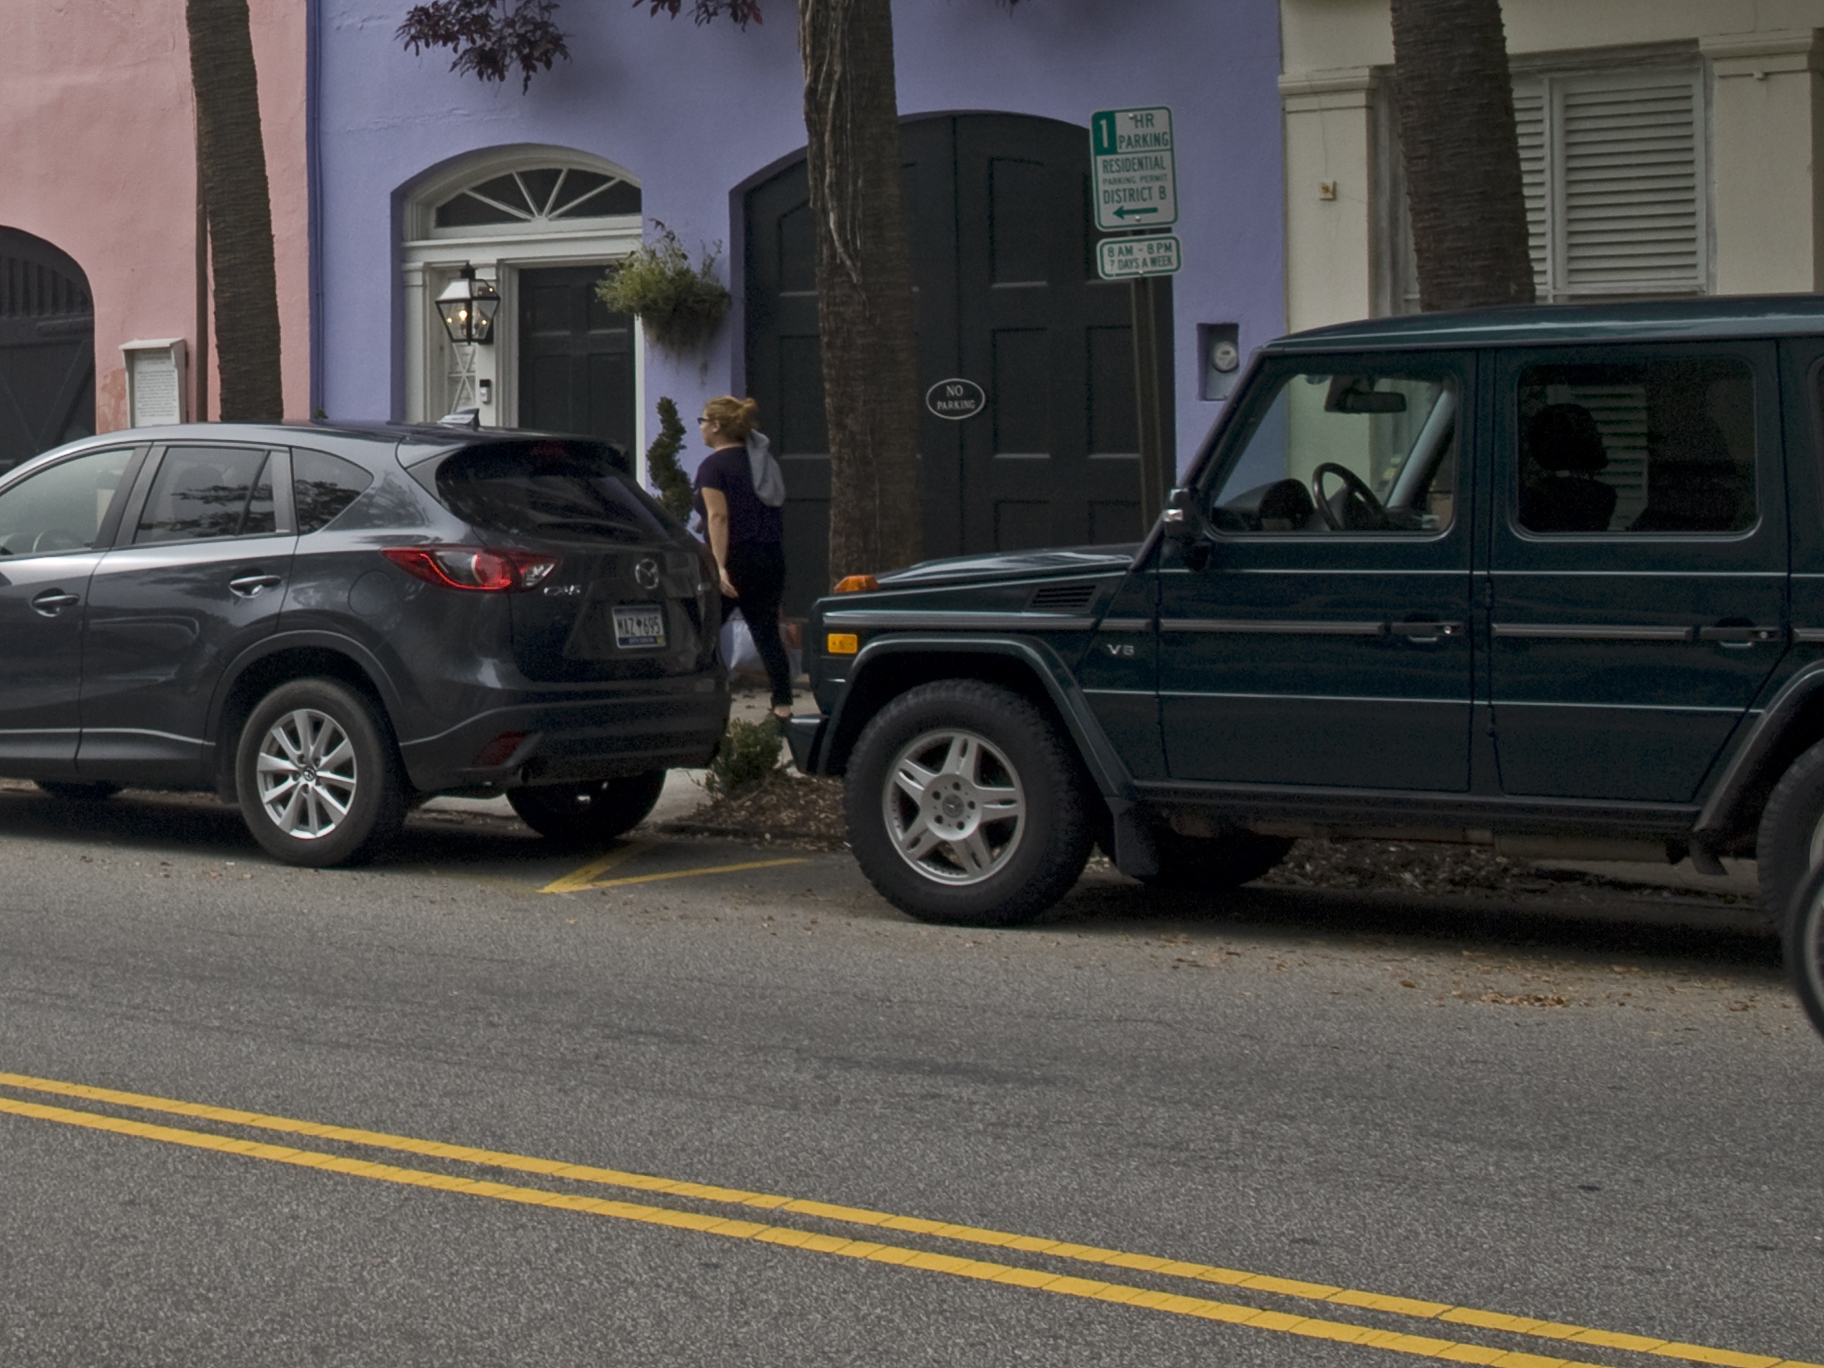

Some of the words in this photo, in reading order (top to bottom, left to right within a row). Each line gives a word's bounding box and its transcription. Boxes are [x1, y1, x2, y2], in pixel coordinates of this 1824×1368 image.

[1134, 113, 1155, 129] HR
[1099, 118, 1109, 149] 1
[1118, 131, 1169, 150] PARKING
[1102, 155, 1166, 174] RESIDENTIAL
[1102, 175, 1137, 186] PARKING
[1139, 173, 1168, 183] PERMIT
[1103, 186, 1153, 205] DISTRICT
[1159, 185, 1167, 201] B
[1107, 246, 1115, 258] 8
[1117, 244, 1134, 257] AM
[1146, 243, 1155, 255] 8
[1156, 242, 1173, 254] PM
[1109, 259, 1115, 271] 7
[1117, 258, 1140, 271] DAYS
[1142, 257, 1149, 269] A
[1150, 255, 1174, 268] WEEK
[946, 385, 964, 397] NO
[937, 399, 976, 411] PARKING
